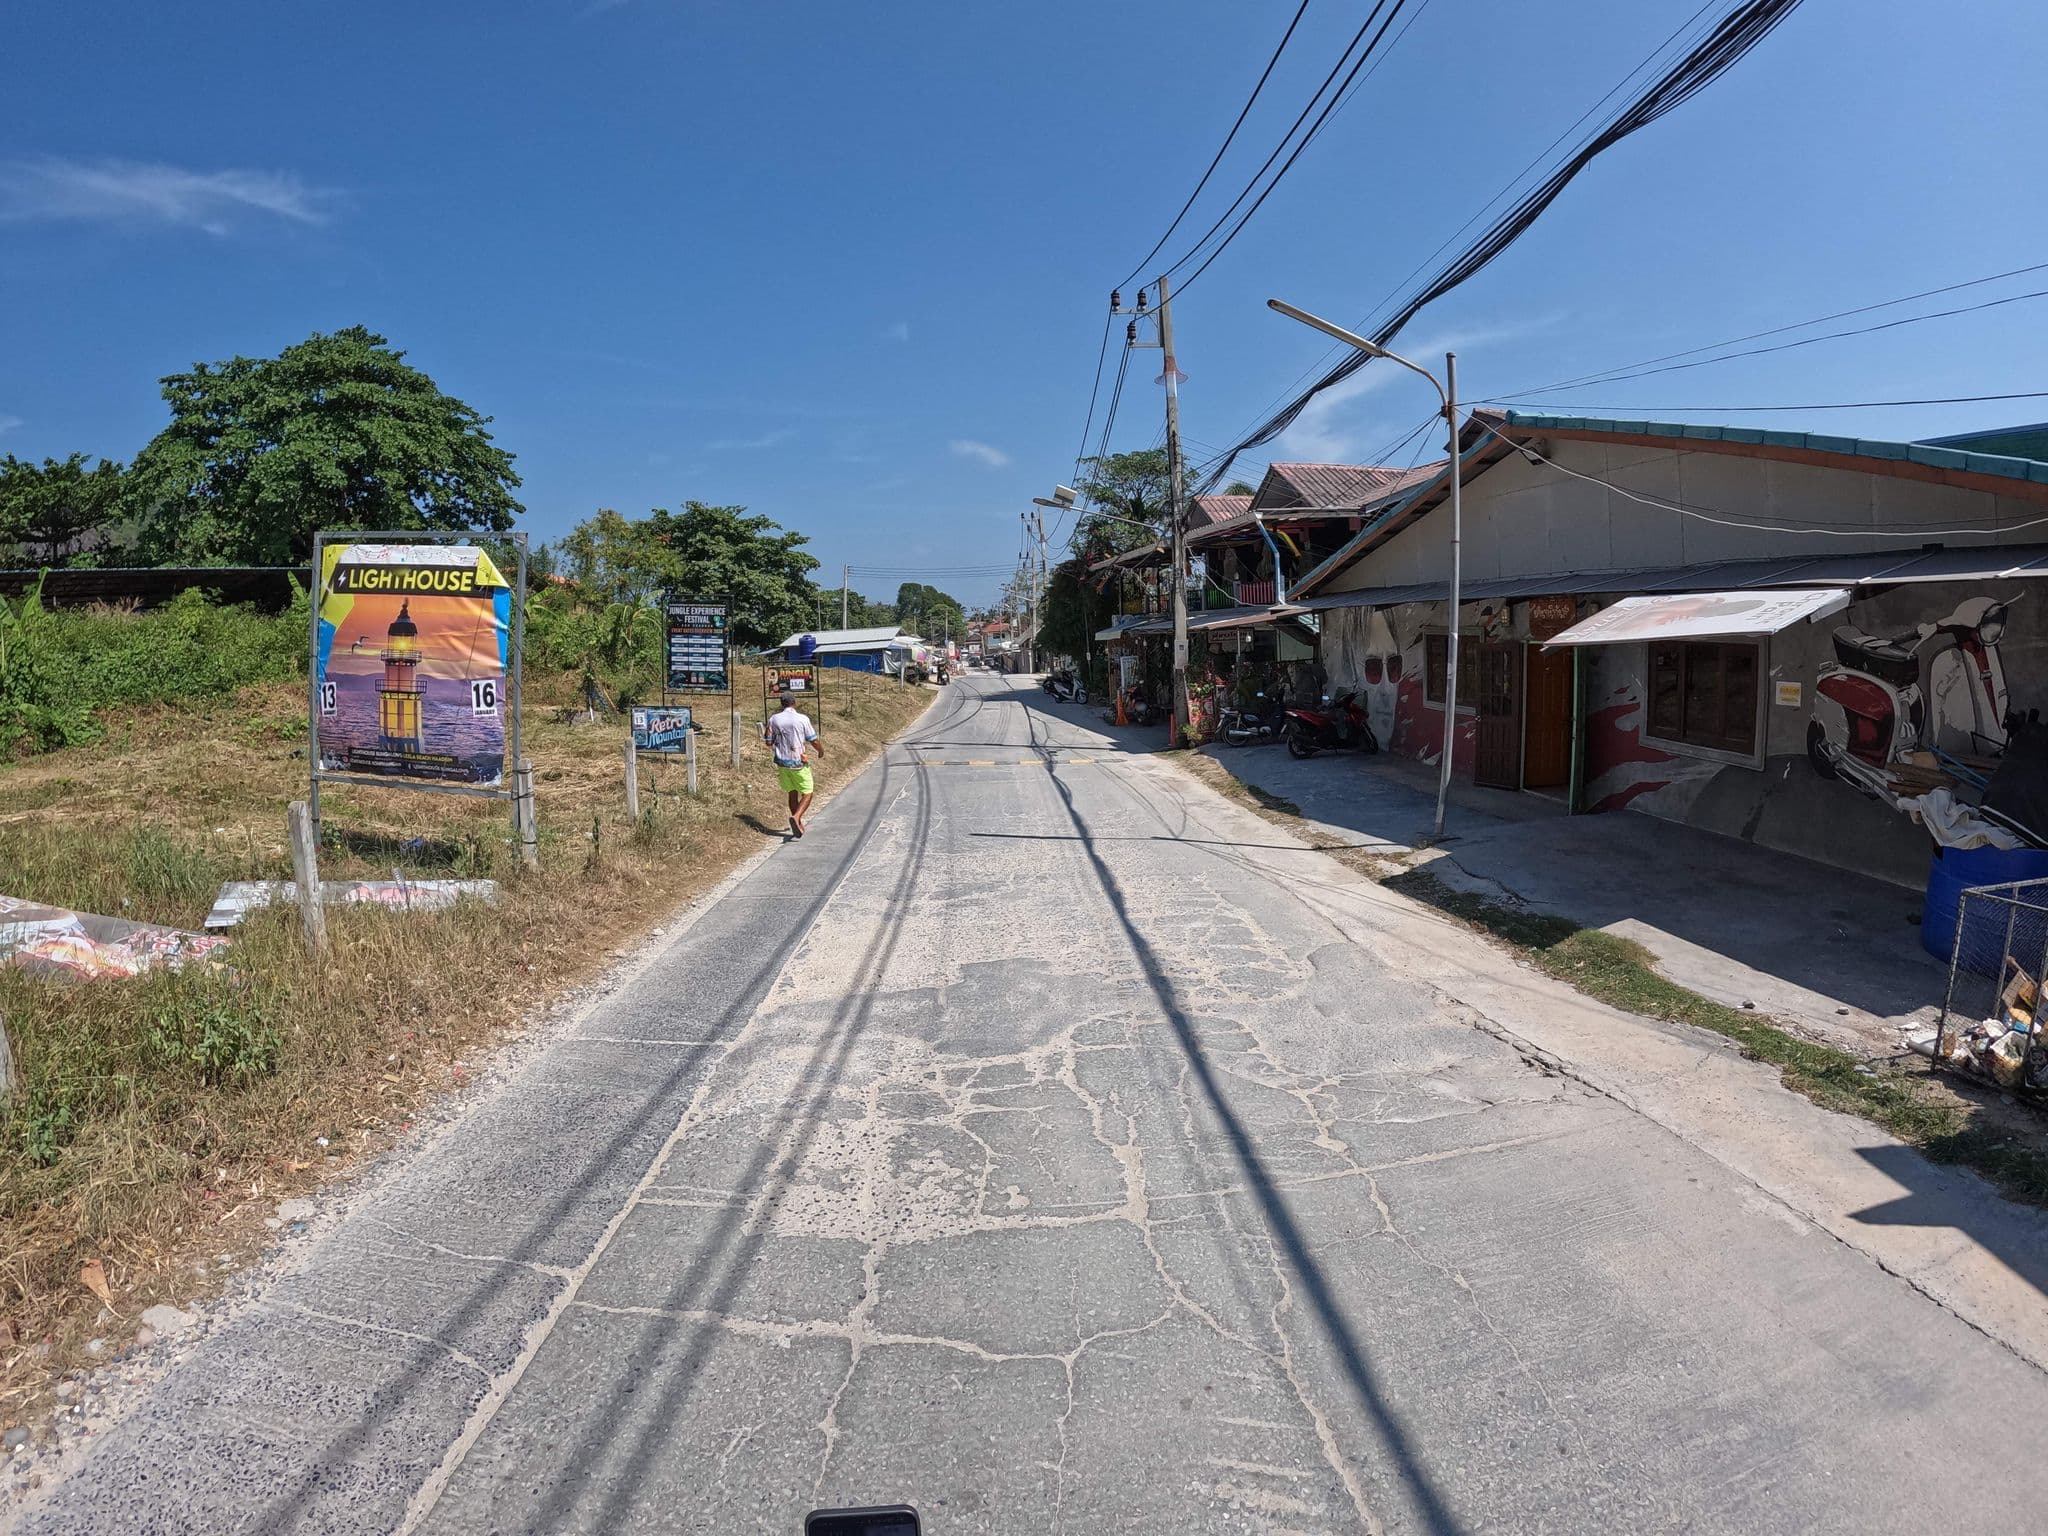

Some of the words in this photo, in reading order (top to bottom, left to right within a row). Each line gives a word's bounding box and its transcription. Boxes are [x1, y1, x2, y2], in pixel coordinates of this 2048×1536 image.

[349, 569, 474, 592] LIGHTHOUSE
[669, 607, 690, 615] JUNGLE
[691, 607, 726, 615] EXPERIENCE
[684, 615, 710, 624] FESTIVAL
[322, 684, 336, 709] 13
[473, 682, 495, 708] 16
[649, 715, 684, 734] Retro
